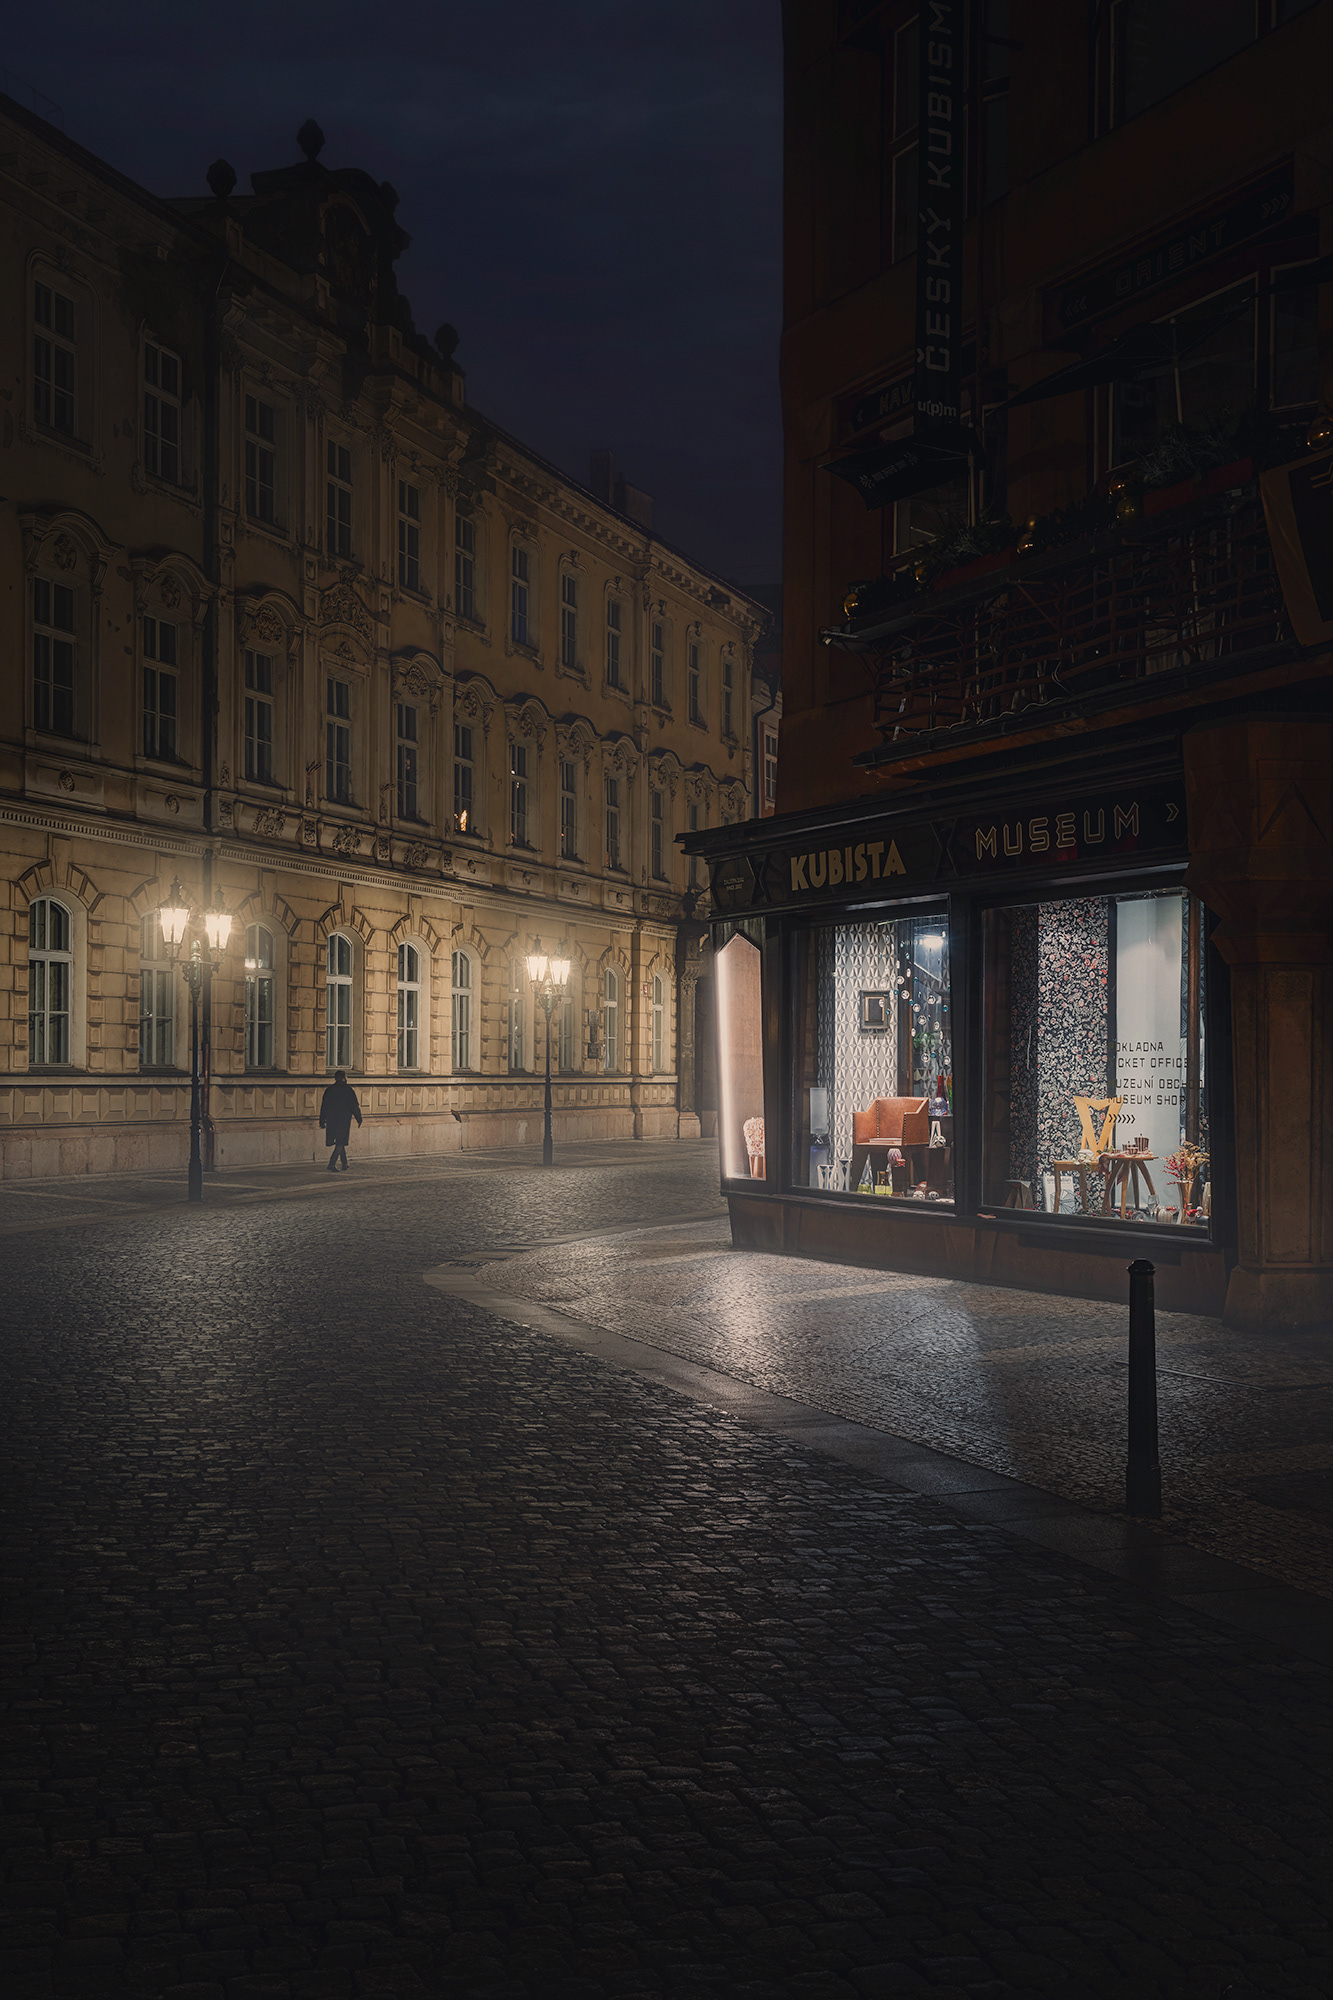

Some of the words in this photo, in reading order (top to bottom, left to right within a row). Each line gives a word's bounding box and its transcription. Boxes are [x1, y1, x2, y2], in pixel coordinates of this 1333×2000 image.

[1116, 219, 1227, 297] ORIENT
[917, 207, 952, 373] ČESKÝ
[879, 381, 916, 415] KAV
[975, 801, 1140, 861] MUSEUM
[790, 838, 907, 892] KUBISTA
[1150, 1057, 1189, 1068] OFFICE
[1156, 1094, 1186, 1106] SHOP
